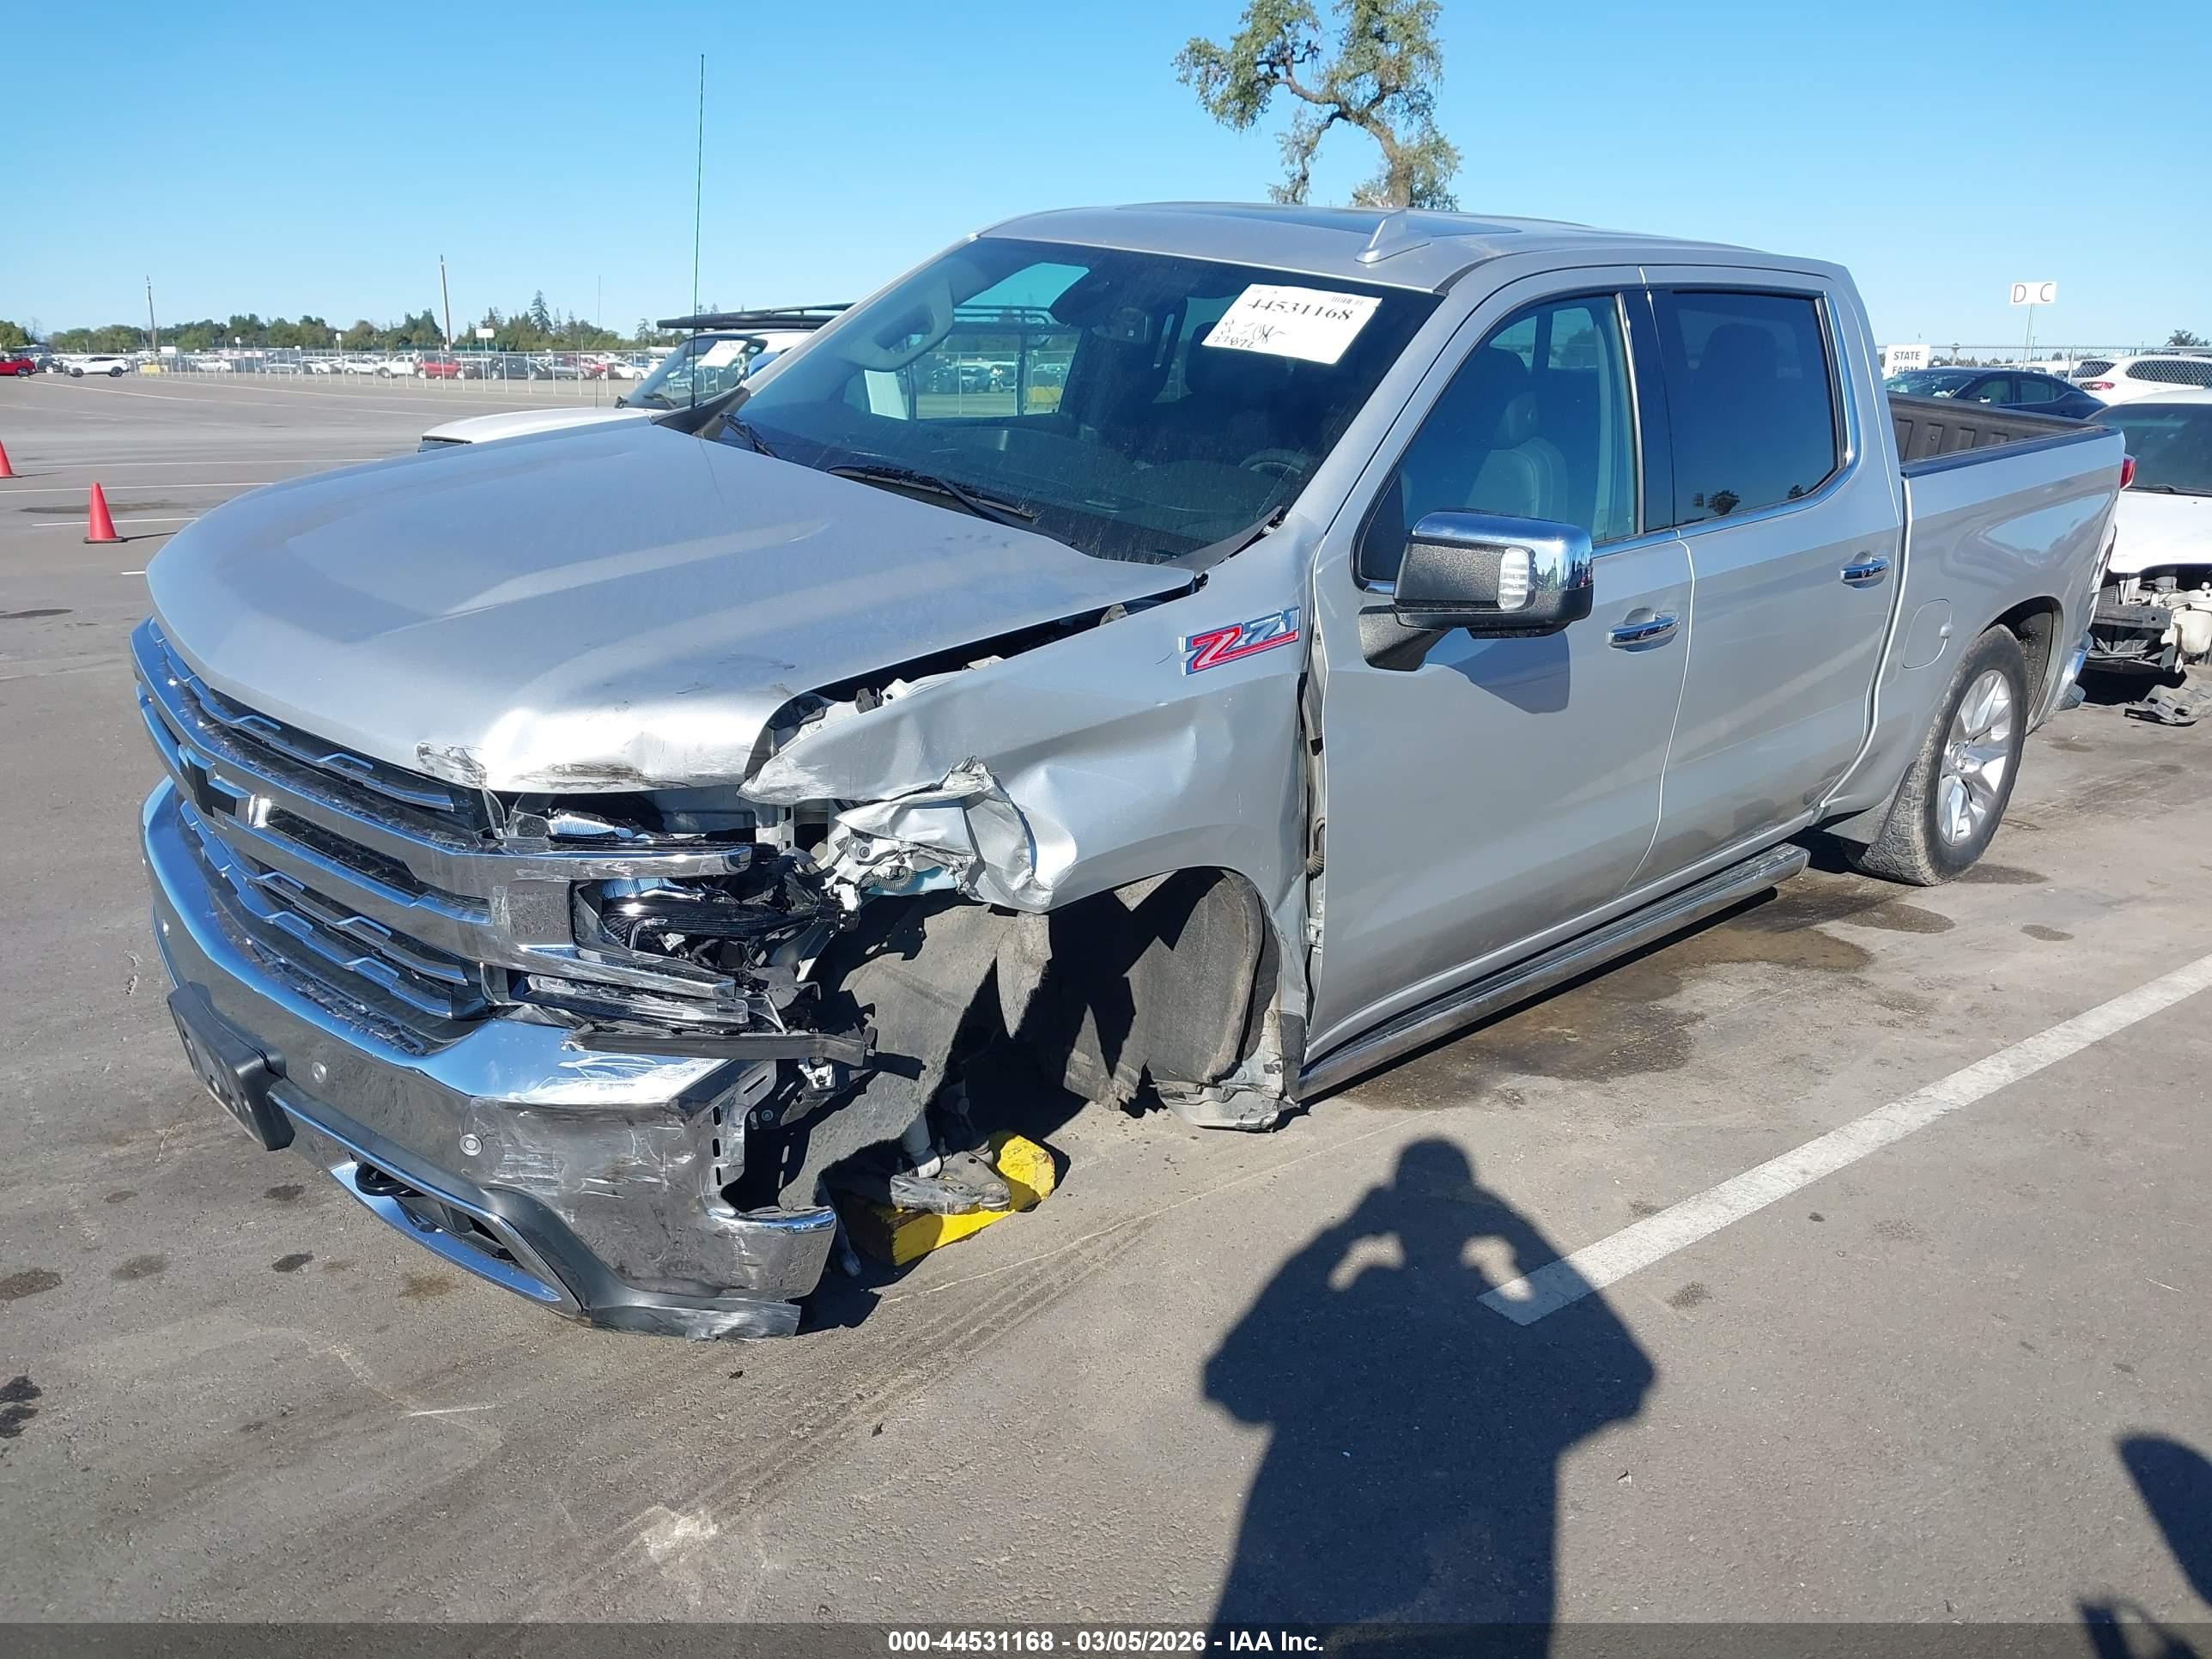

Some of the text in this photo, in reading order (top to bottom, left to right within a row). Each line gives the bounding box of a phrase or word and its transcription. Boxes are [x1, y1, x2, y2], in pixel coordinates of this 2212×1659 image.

[2014, 283, 2052, 302] D C
[1247, 298, 1353, 320] 44531168
[1893, 351, 1921, 361] STATE
[1179, 606, 1300, 676] Z71
